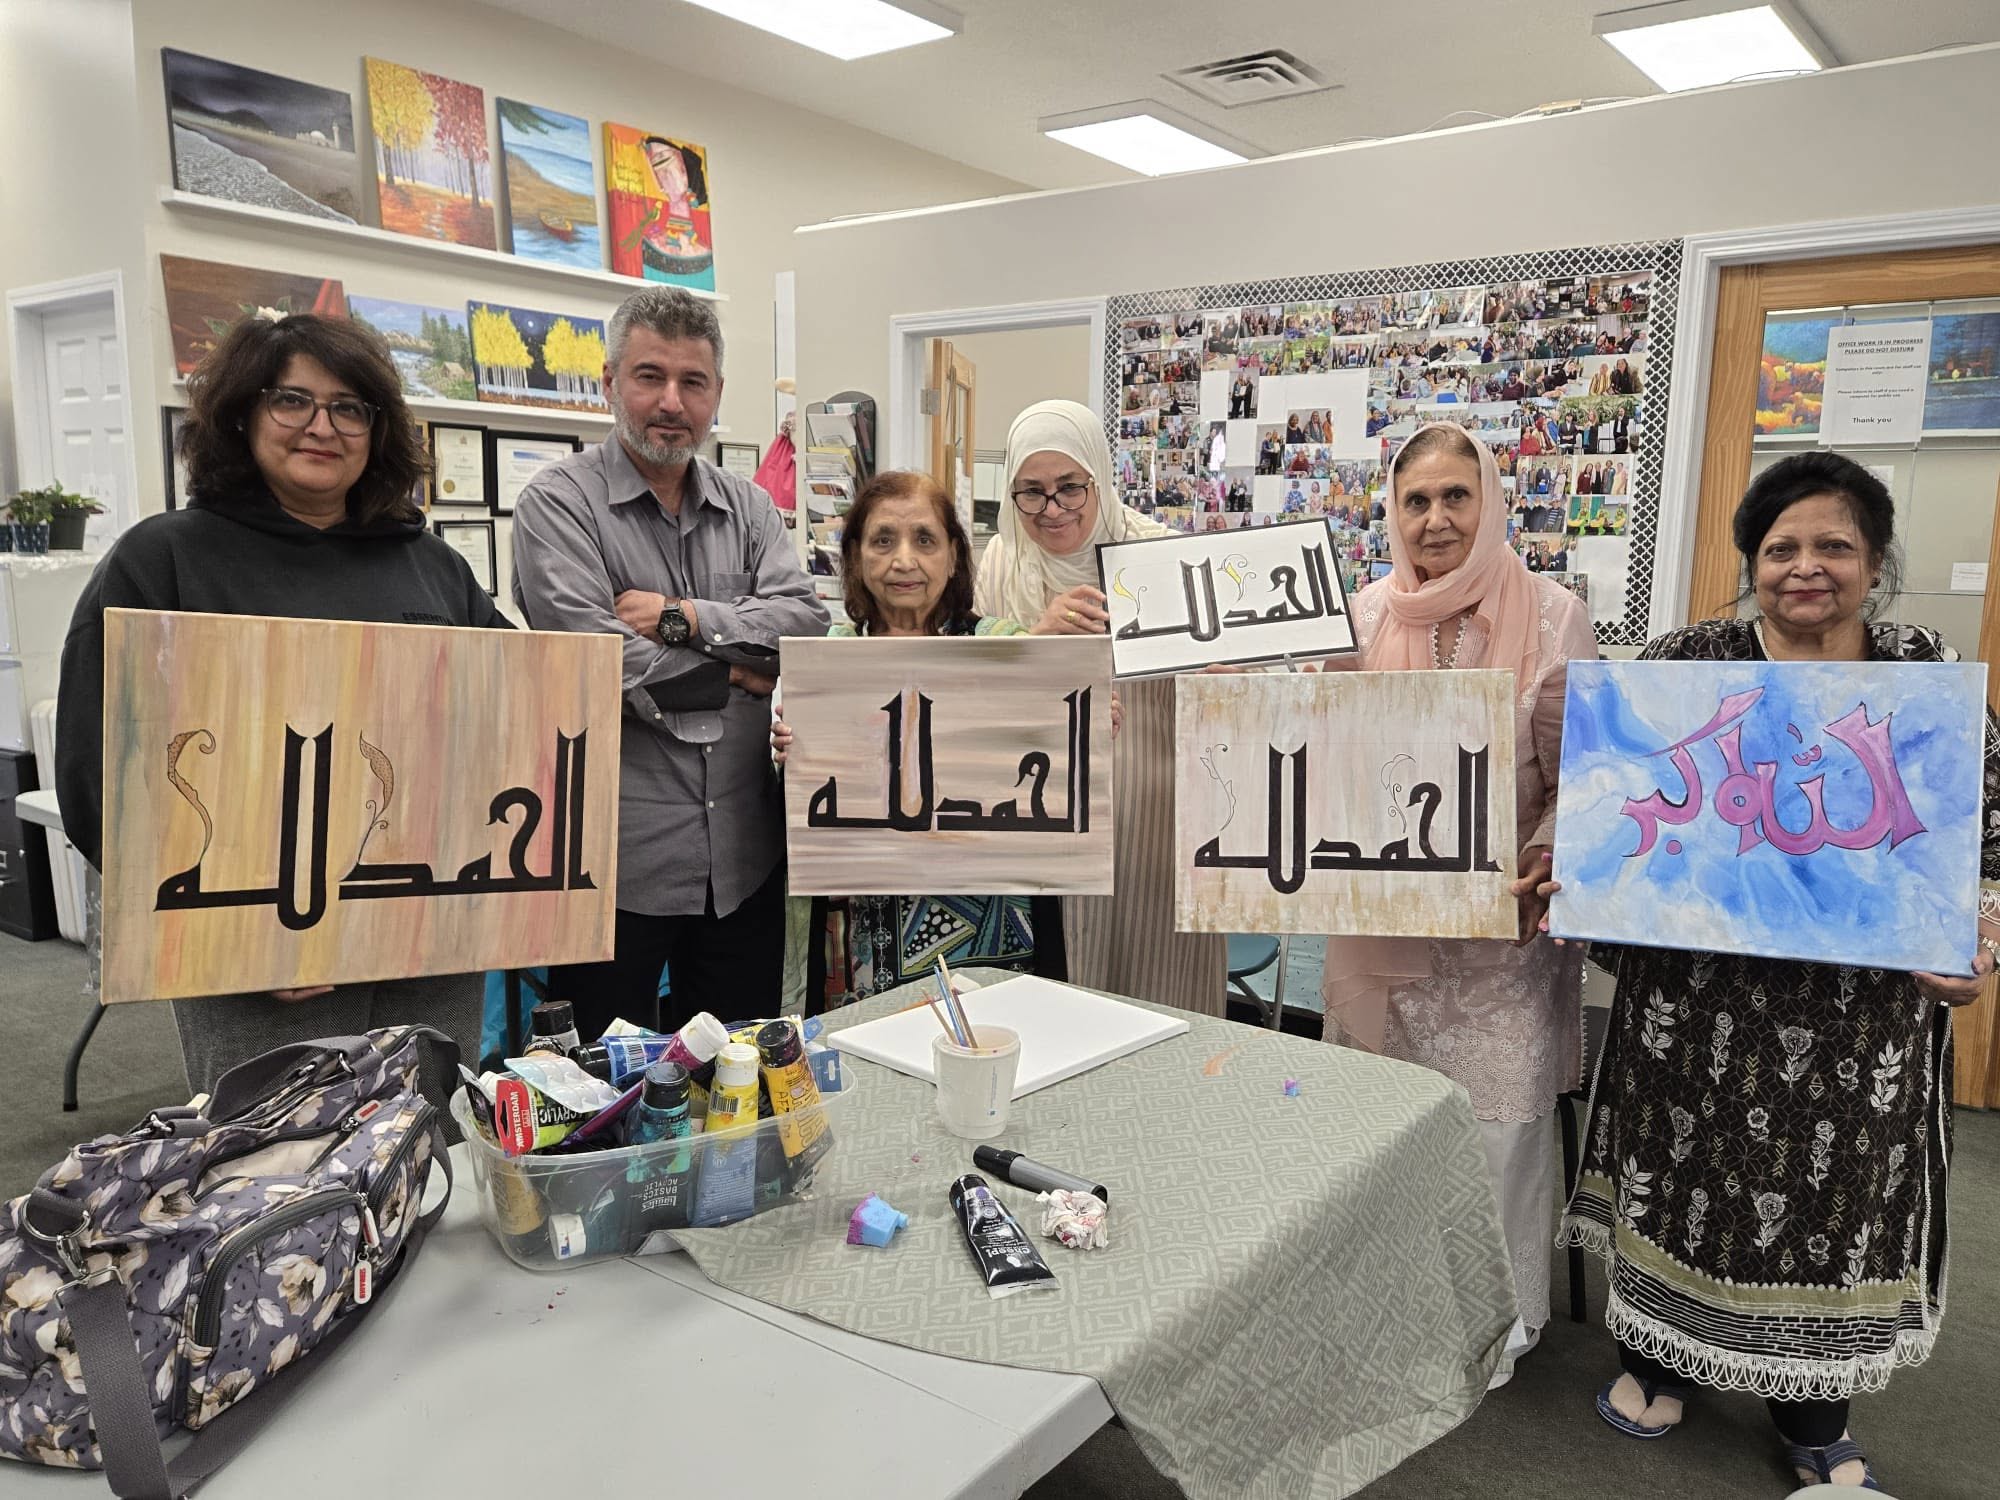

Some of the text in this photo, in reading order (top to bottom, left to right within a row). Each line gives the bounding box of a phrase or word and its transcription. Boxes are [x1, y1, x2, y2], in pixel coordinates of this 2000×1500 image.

[1852, 416, 1875, 424] Thank
[510, 1091, 525, 1147] AMSTERDAM
[642, 1186, 678, 1200] BASICS
